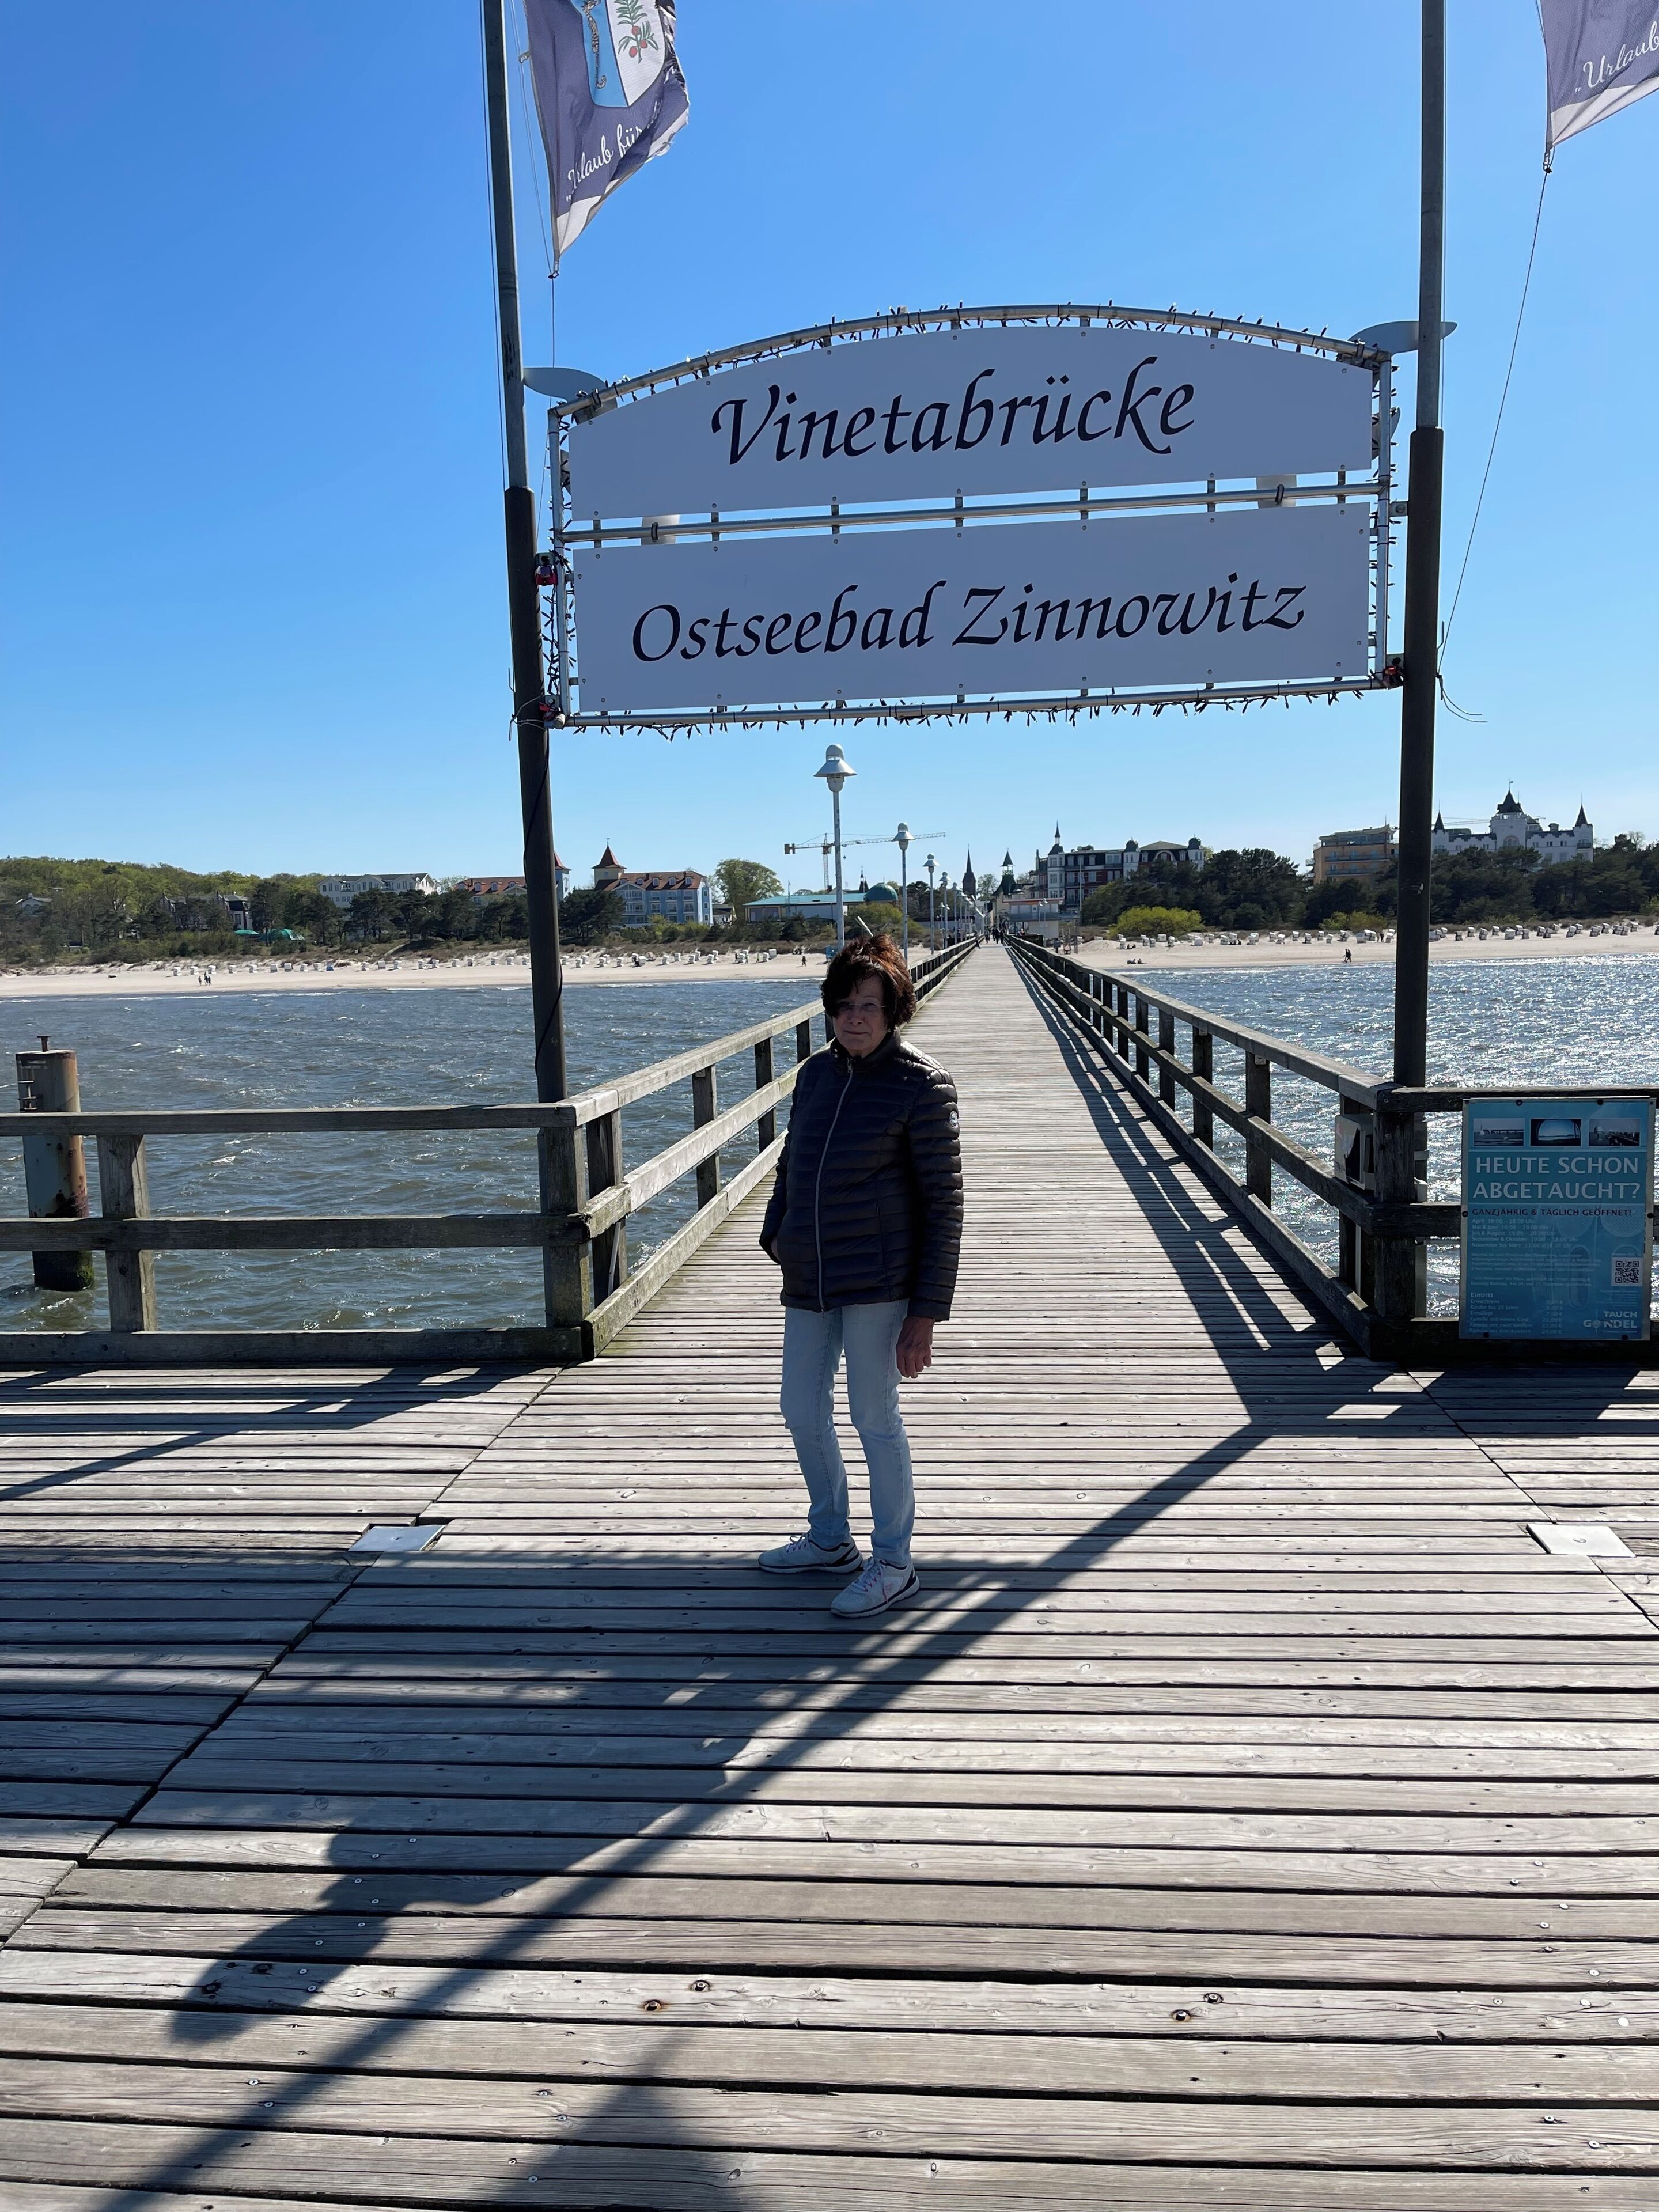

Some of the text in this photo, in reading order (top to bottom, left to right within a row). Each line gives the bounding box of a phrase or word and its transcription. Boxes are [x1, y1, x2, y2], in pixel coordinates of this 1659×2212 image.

[711, 356, 1195, 465] Vinetabrücke
[632, 572, 1307, 662] Ostseebad Zinnowitz
[1476, 1157, 1639, 1174] HEUTE SCHON
[1472, 1181, 1641, 1199] ABGETAUCHT?
[1603, 1310, 1638, 1319] TAUCH
